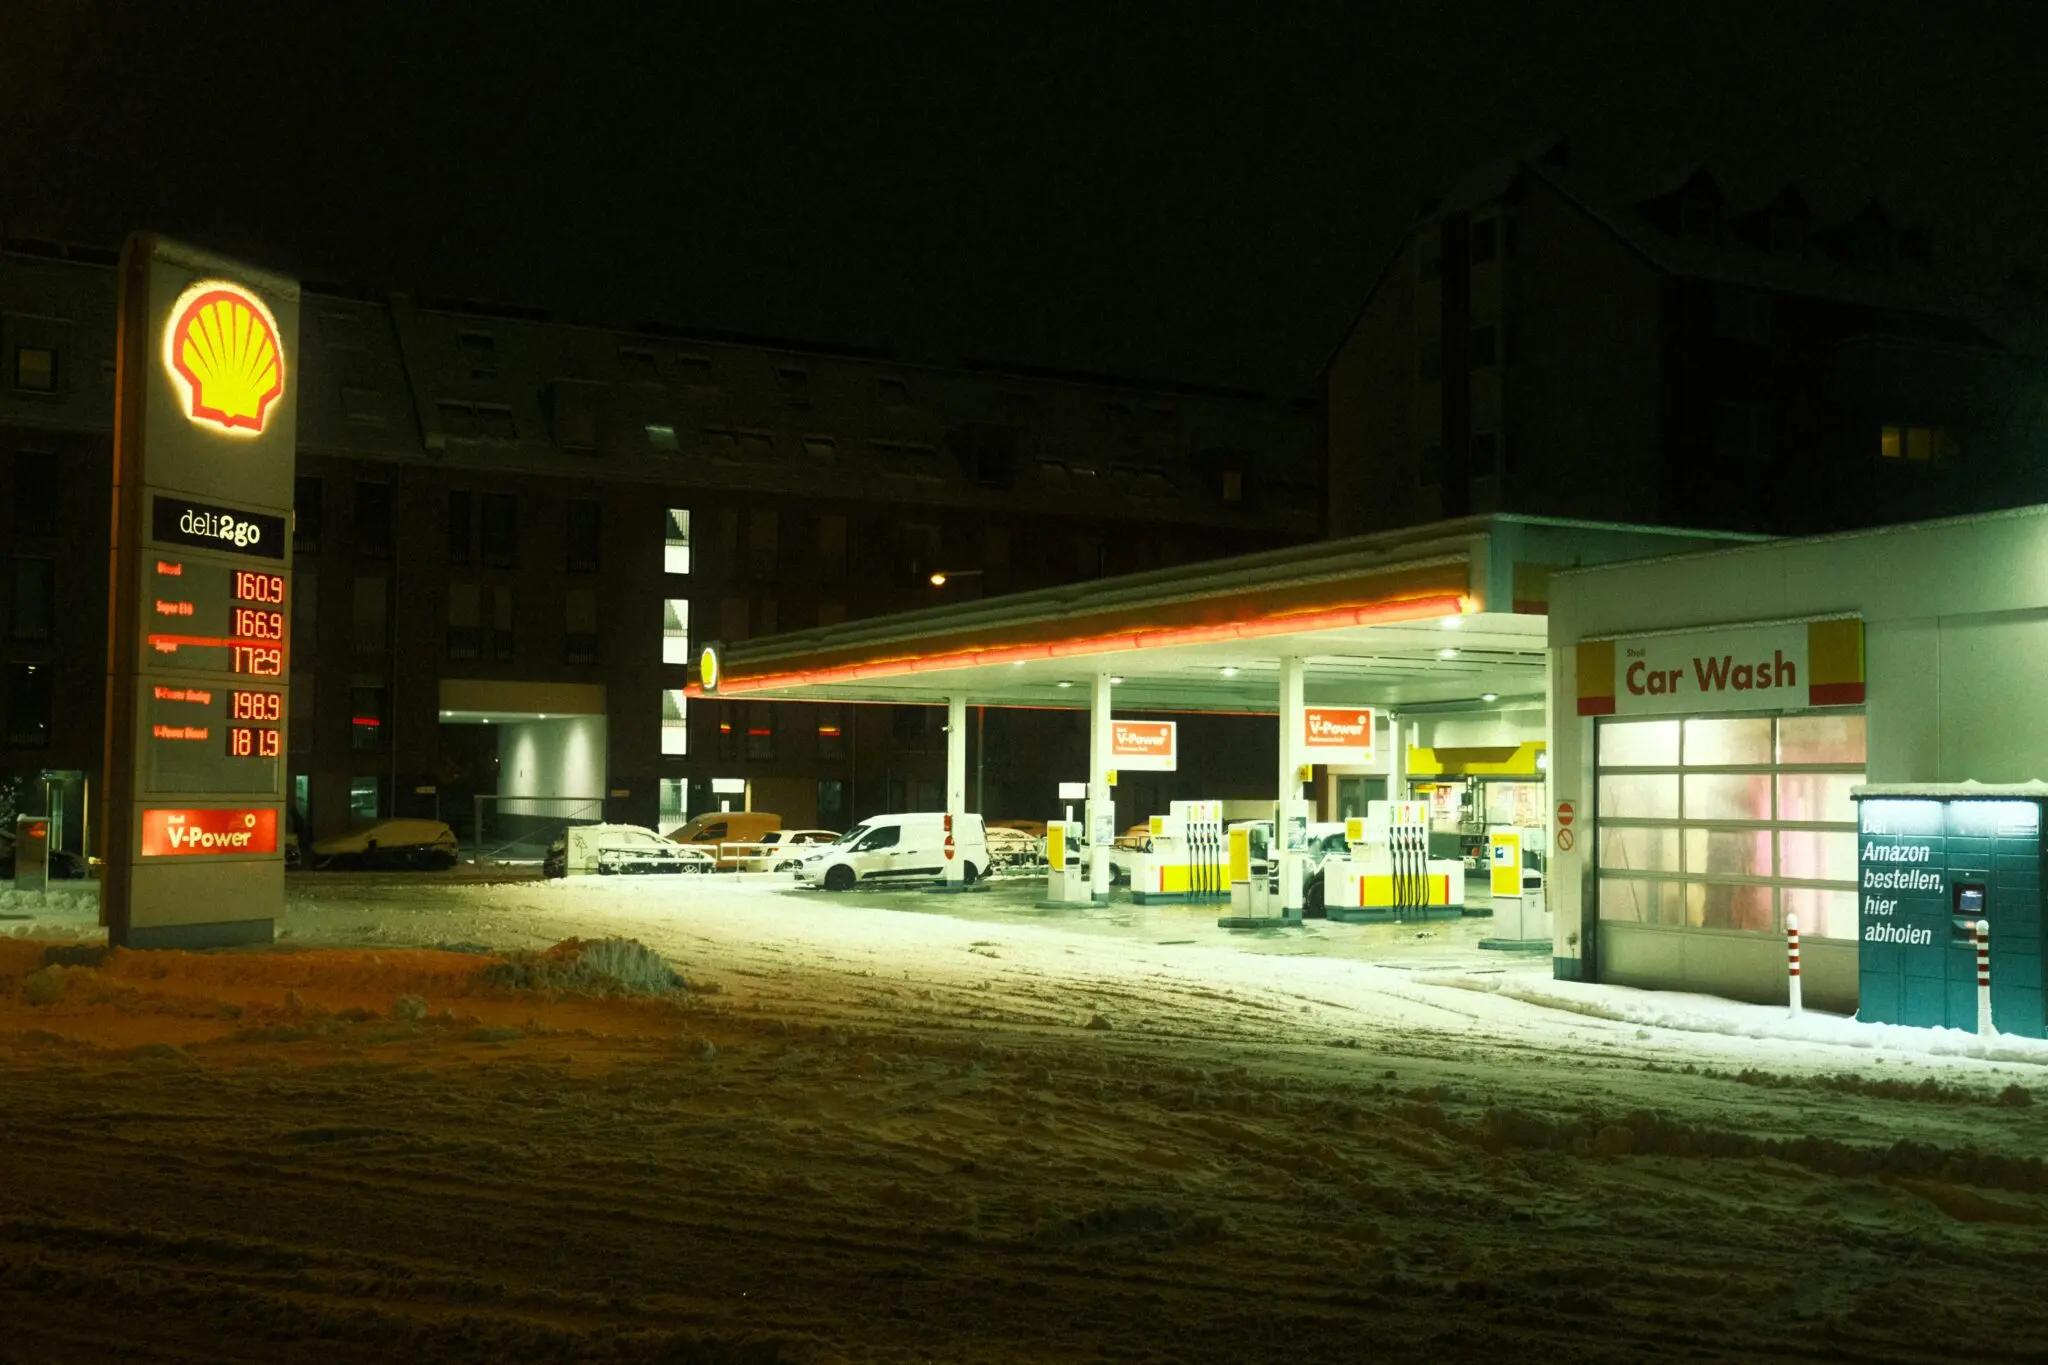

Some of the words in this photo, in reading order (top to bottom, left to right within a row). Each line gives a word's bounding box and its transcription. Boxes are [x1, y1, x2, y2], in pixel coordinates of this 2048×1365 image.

[180, 510, 260, 547] deli2go
[237, 572, 283, 603] 160.9
[236, 609, 282, 639] 166.9
[235, 646, 281, 676] 172.9
[1626, 660, 1683, 696] Car
[1693, 649, 1797, 692] Wash
[234, 692, 280, 720] 198.9
[168, 826, 252, 848] V-Power
[1862, 841, 1930, 862] Amazon
[1863, 868, 1944, 893] bestellen,
[1864, 895, 1897, 916] hier
